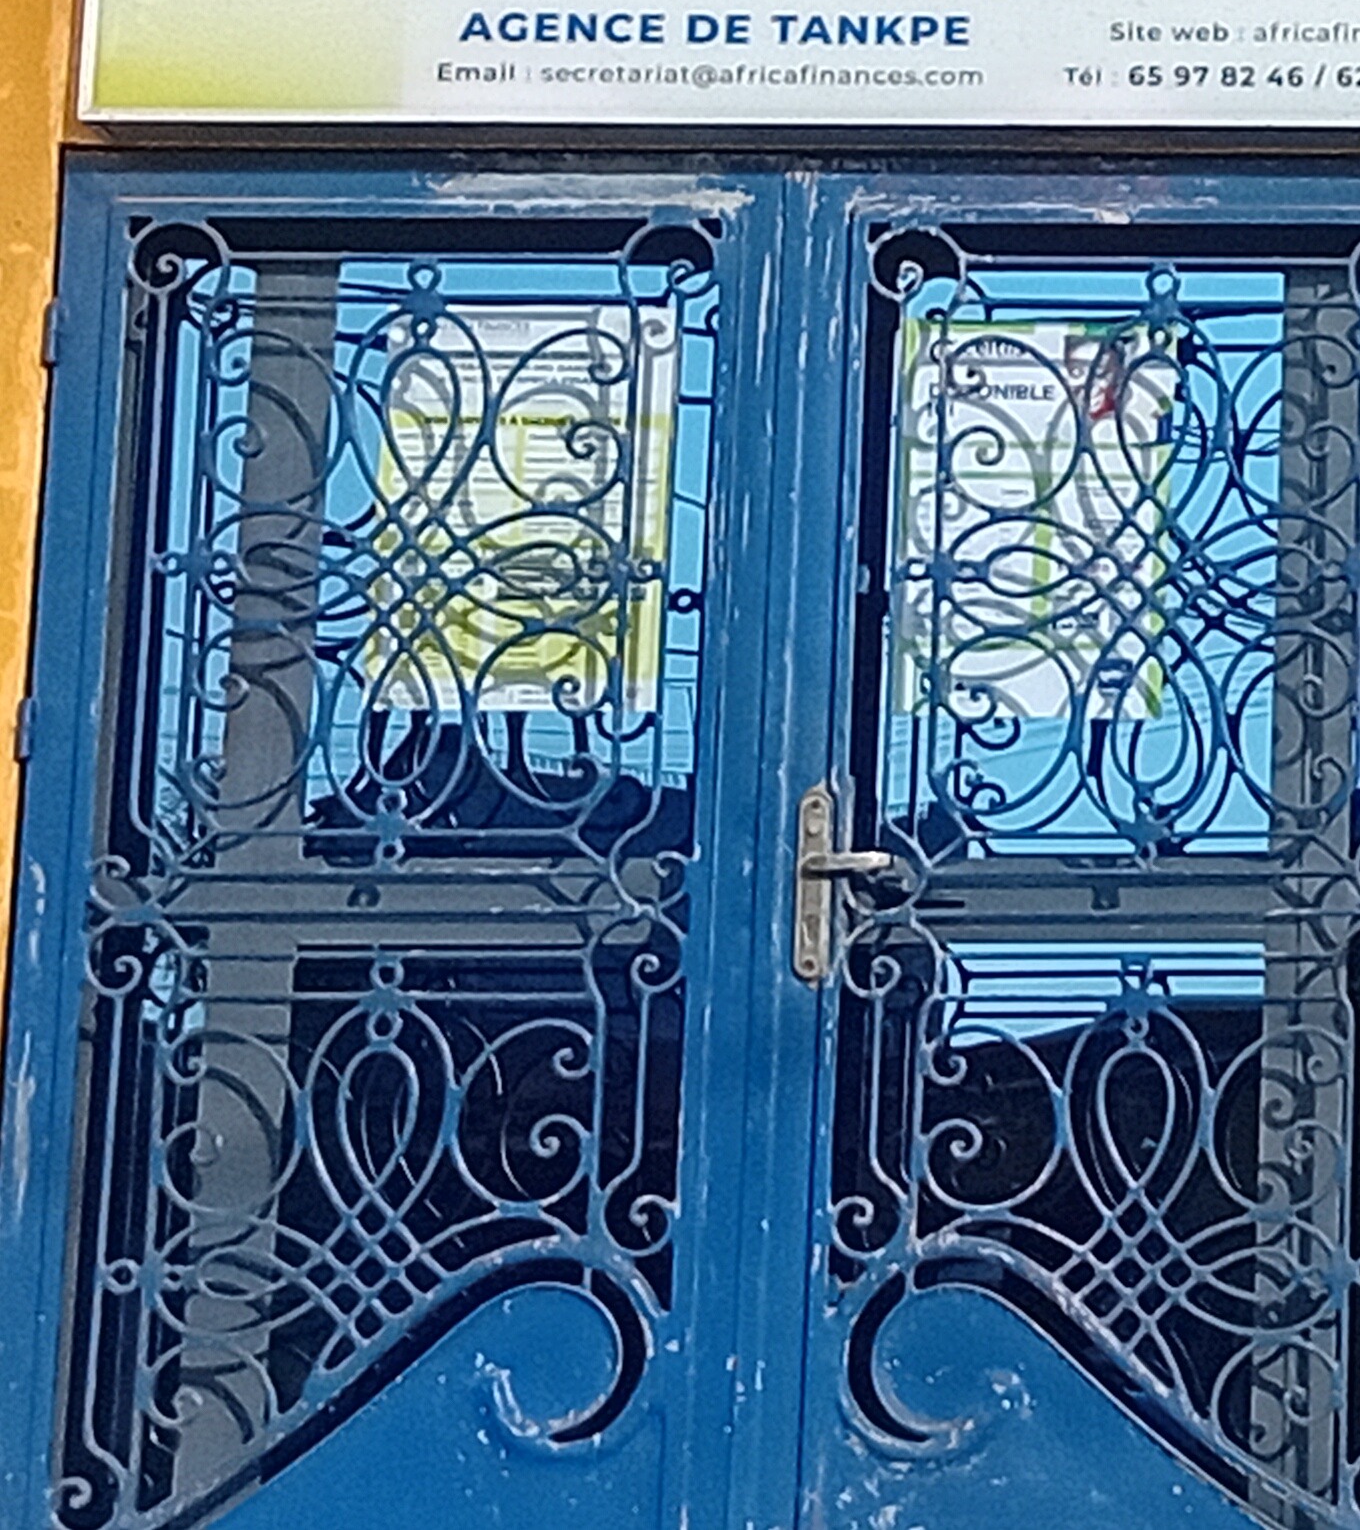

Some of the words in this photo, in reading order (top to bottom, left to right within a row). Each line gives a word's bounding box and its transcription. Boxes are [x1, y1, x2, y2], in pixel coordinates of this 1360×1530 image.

[459, 12, 667, 45] AGENCE
[686, 14, 753, 46] DE
[771, 15, 972, 47] TANKPE
[1110, 21, 1163, 43] Site
[1171, 22, 1230, 43] web
[437, 63, 515, 83] Email
[541, 64, 983, 90] secretariat@africafinances.com
[1063, 65, 1102, 86] Tél
[1128, 65, 1164, 87] 65
[1174, 65, 1210, 87] 97
[1220, 65, 1256, 87] 82
[1266, 66, 1304, 88] 46
[1313, 64, 1327, 89] /
